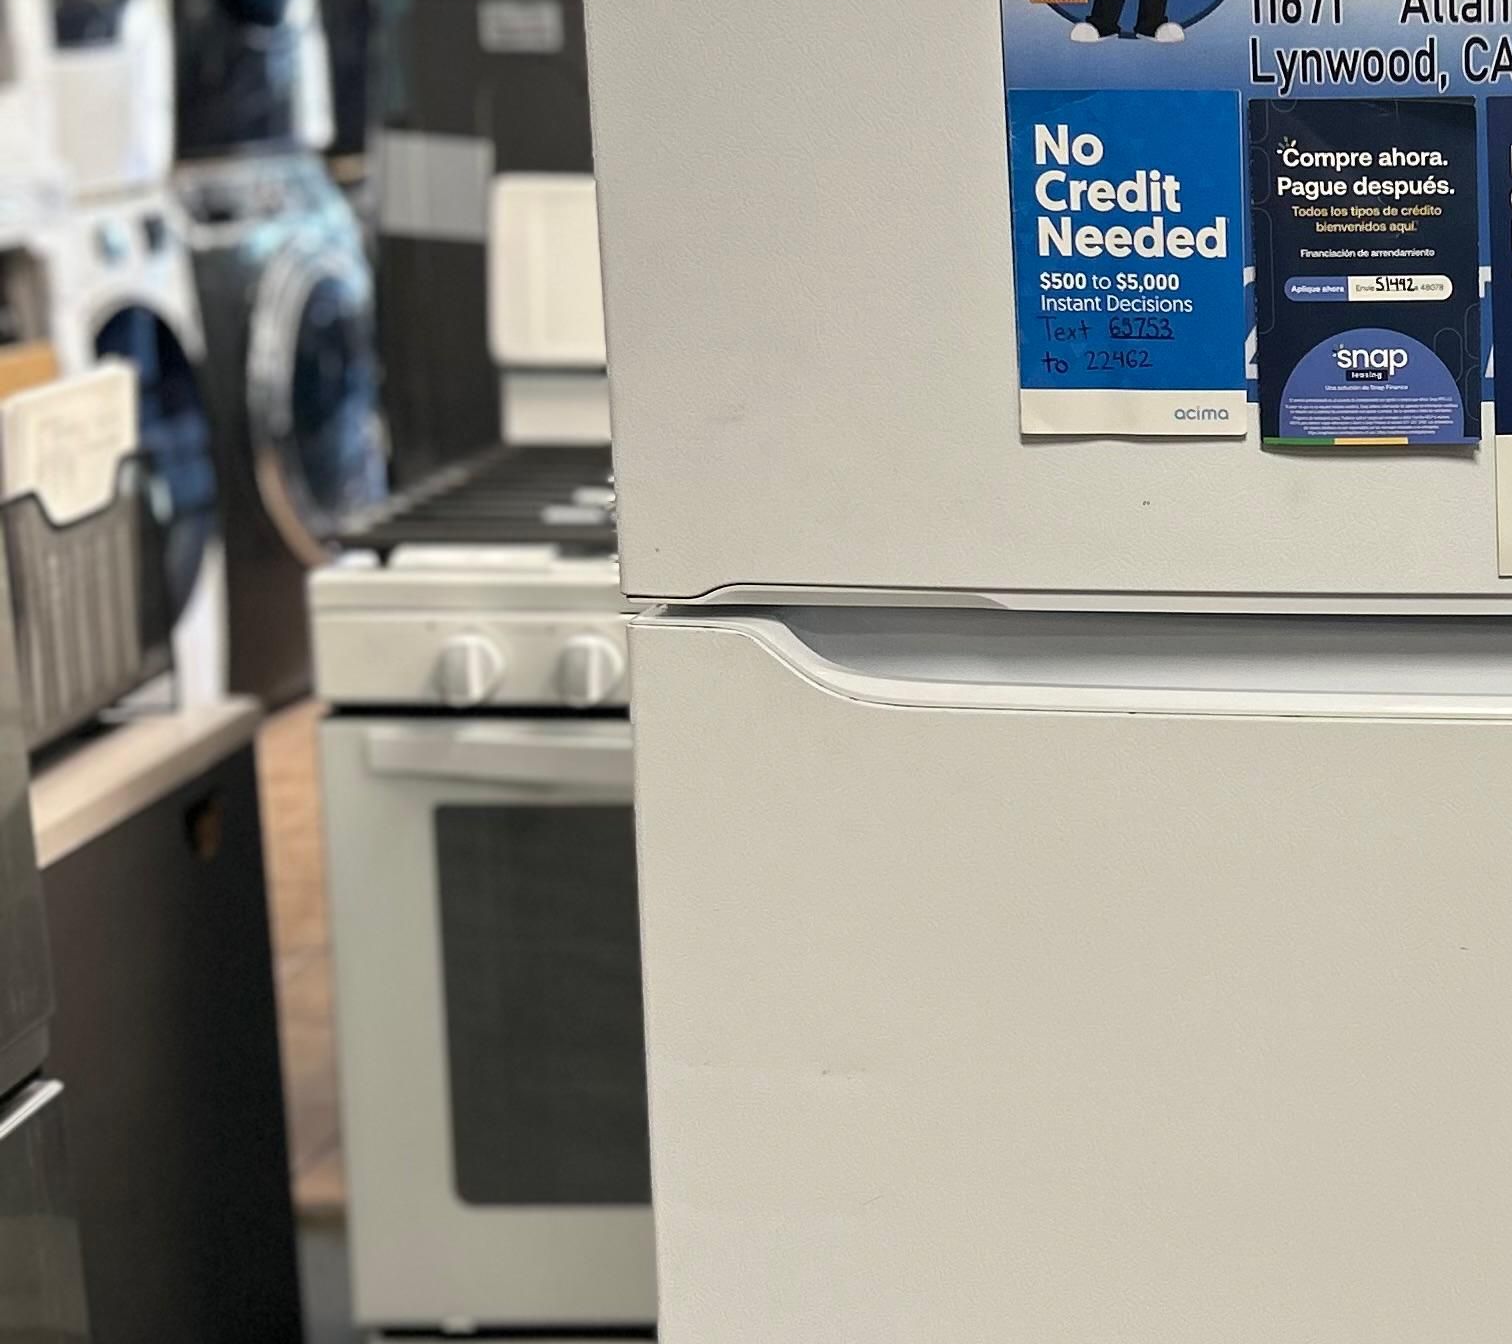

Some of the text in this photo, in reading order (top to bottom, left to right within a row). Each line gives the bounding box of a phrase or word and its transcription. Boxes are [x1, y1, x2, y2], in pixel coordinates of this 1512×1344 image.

[1250, 37, 1448, 92] Lynwood,
[1034, 124, 1104, 166] No
[1282, 147, 1449, 171] Compre ahora.
[1035, 169, 1181, 213] Credit
[1277, 175, 1455, 200] Pague después.
[1291, 204, 1442, 218] Todos los tipos de crédito
[1037, 216, 1227, 258] Needed
[1316, 221, 1386, 233] bienvenidos
[1300, 248, 1435, 258] Financiación de arrendamiento
[1040, 271, 1180, 292] $500 to $5,000
[1041, 294, 1193, 313] Instant Decisions
[1036, 316, 1091, 342] Text
[1041, 350, 1153, 373] to 22462
[1337, 348, 1407, 375] snap
[1174, 406, 1229, 420] acima
